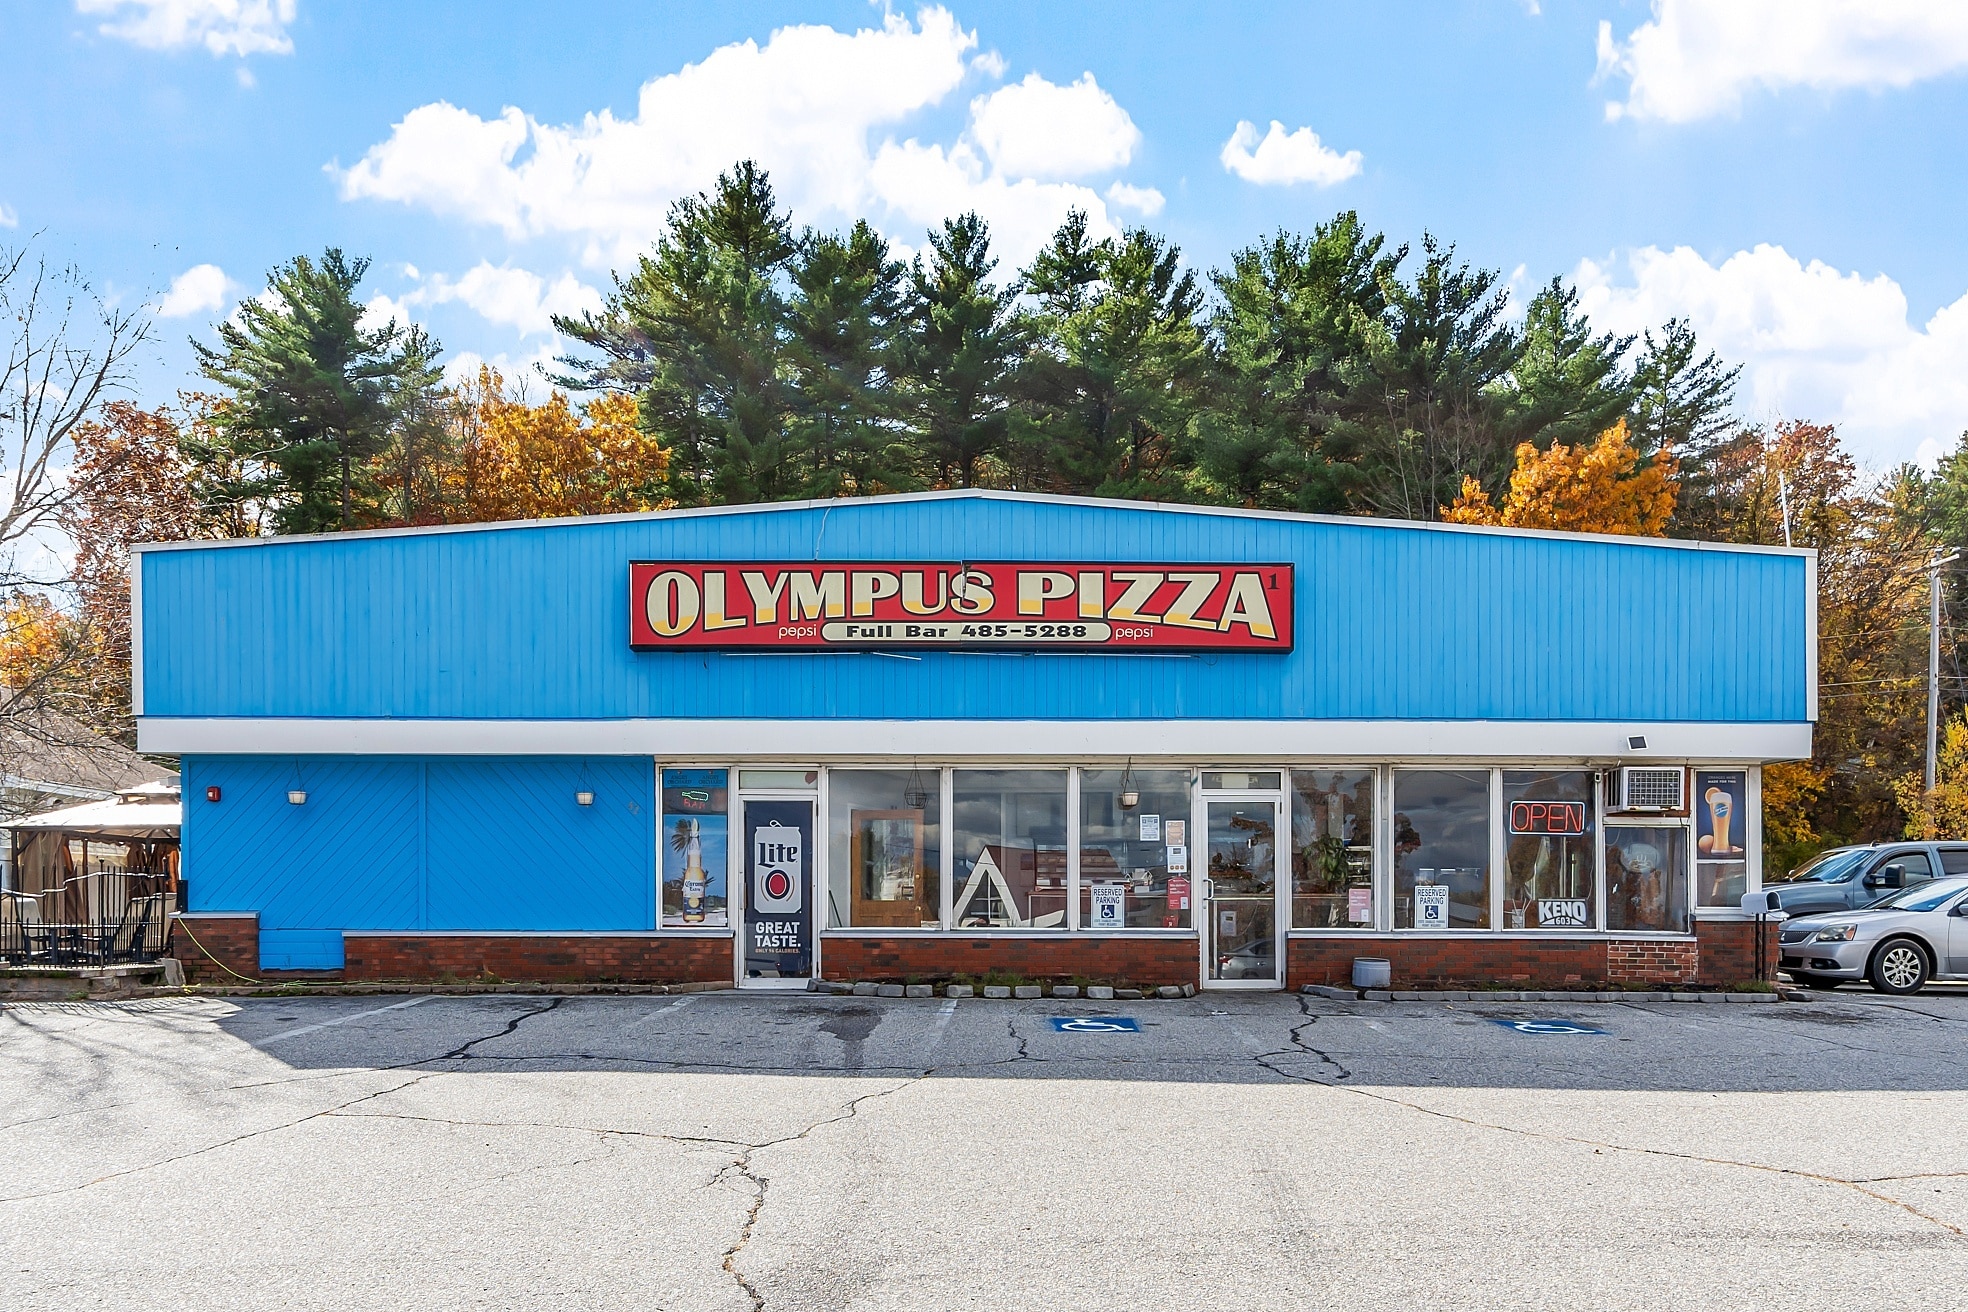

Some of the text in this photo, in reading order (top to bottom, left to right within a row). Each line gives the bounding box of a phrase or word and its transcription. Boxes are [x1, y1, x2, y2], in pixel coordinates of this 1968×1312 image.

[645, 569, 1280, 641] OLYMPUS PIZZA 1
[778, 624, 817, 639] pepsi
[846, 625, 1087, 638] Full Bar 485-5288
[1115, 625, 1154, 640] pepsi
[1512, 803, 1583, 832] OPEN
[757, 842, 798, 869] Lite
[1093, 888, 1123, 897] RESERVED
[1417, 888, 1447, 897] RESERVED
[1095, 896, 1120, 905] PARKING
[1419, 896, 1444, 905] PARKING
[1538, 901, 1587, 923] KENO
[1555, 916, 1571, 925] 603
[755, 921, 801, 934] GREAT
[754, 934, 802, 948] TASTE.
